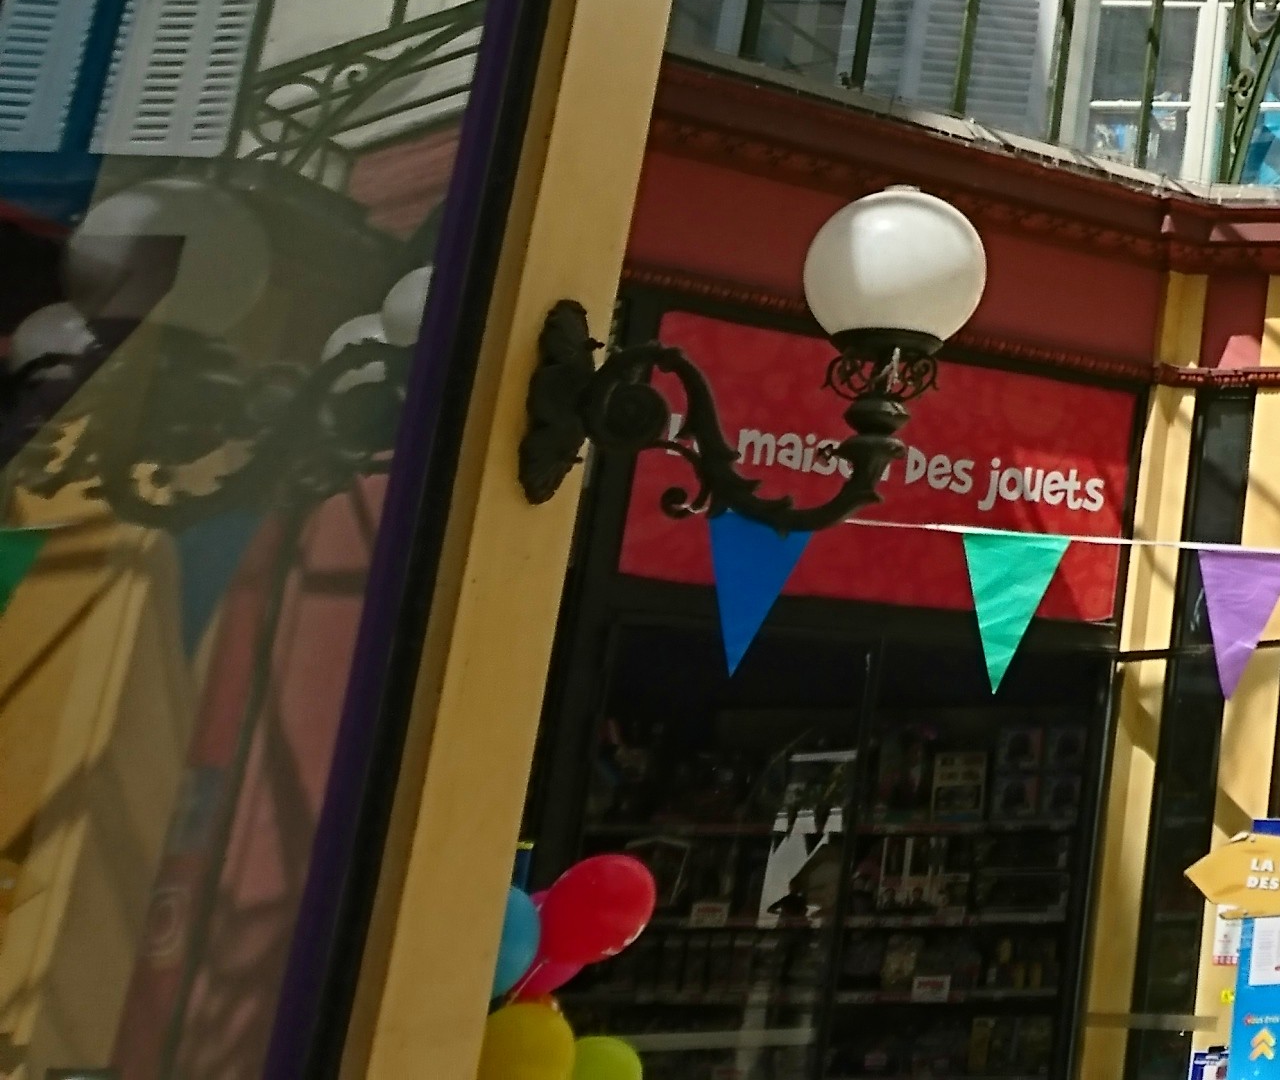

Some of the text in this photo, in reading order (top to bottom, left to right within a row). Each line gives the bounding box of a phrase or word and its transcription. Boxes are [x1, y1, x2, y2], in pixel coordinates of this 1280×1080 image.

[737, 428, 891, 482] mais
[977, 457, 1106, 512] jouets
[1251, 858, 1274, 873] LA
[1246, 875, 1280, 890] DES
